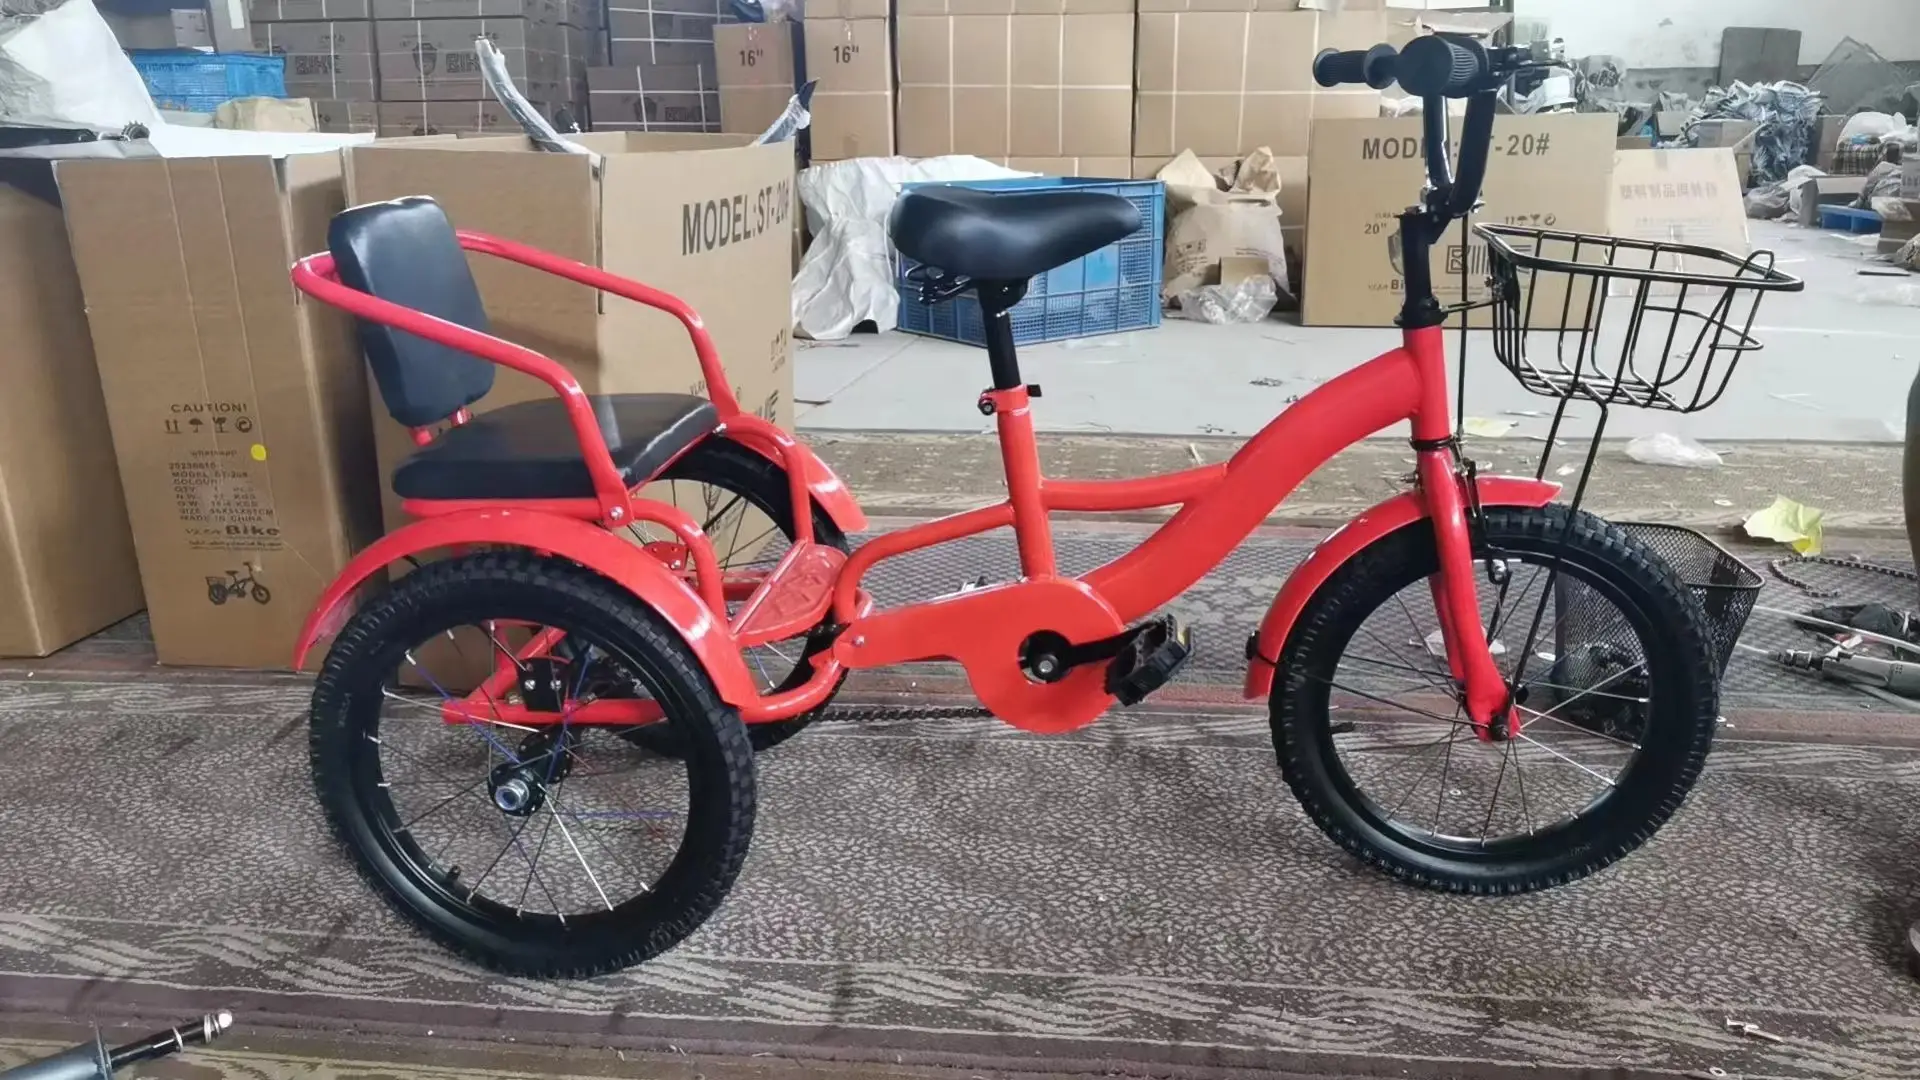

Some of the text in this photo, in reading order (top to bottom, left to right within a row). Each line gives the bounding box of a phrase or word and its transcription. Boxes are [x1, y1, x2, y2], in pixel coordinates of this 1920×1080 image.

[740, 49, 763, 67] 16"
[833, 46, 859, 64] 16"
[1364, 222, 1387, 235] 20"
[171, 402, 247, 413] CAUTION!
[225, 525, 280, 536] Bike
